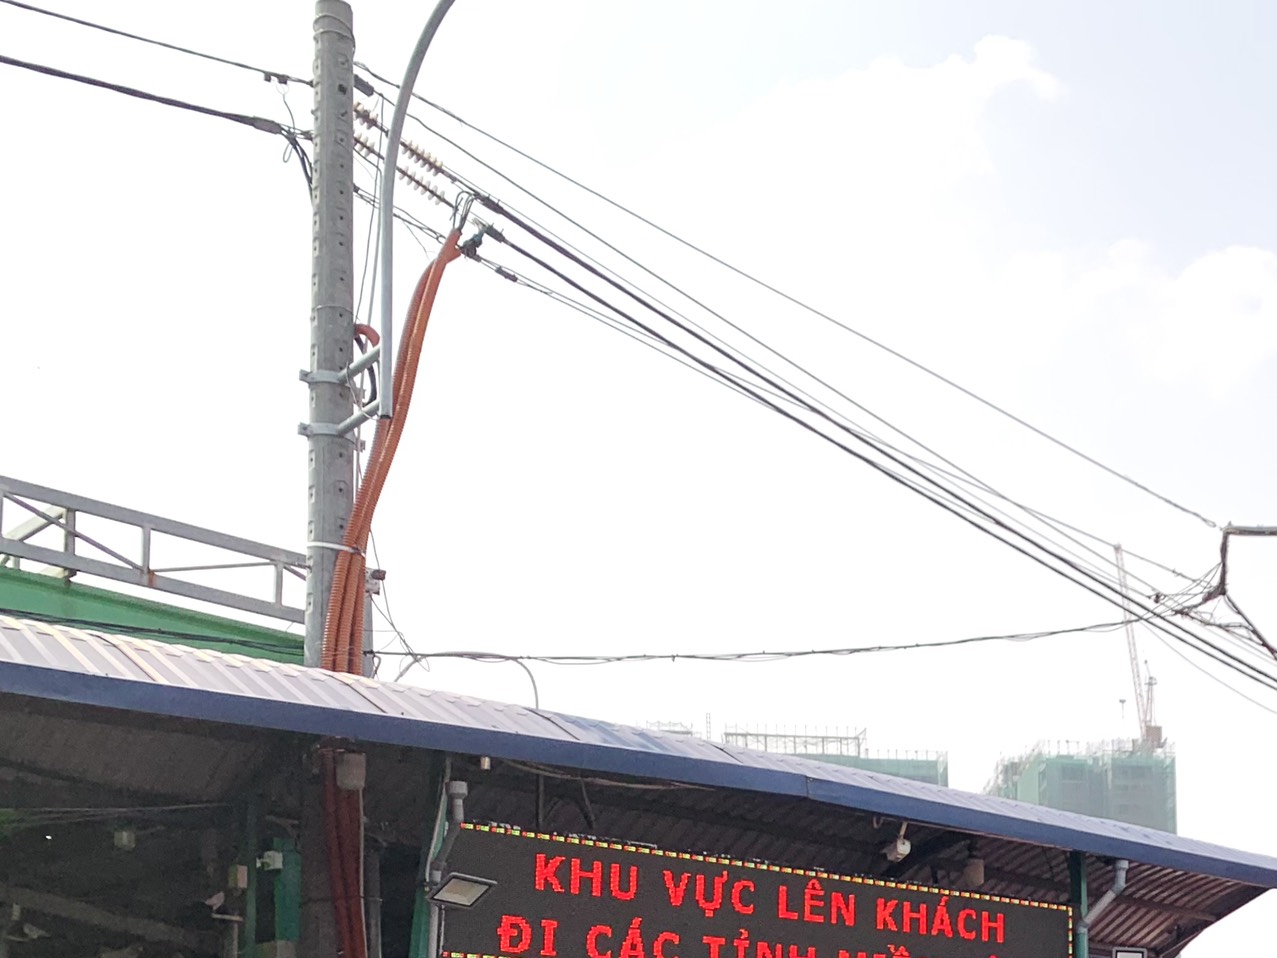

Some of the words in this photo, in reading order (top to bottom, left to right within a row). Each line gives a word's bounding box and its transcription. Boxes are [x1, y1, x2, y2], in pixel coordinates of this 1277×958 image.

[535, 854, 639, 900] KHU
[663, 869, 756, 918] VỰC
[778, 880, 856, 927] LÊN
[876, 895, 1006, 943] KHÁCH
[497, 915, 559, 957] ĐI
